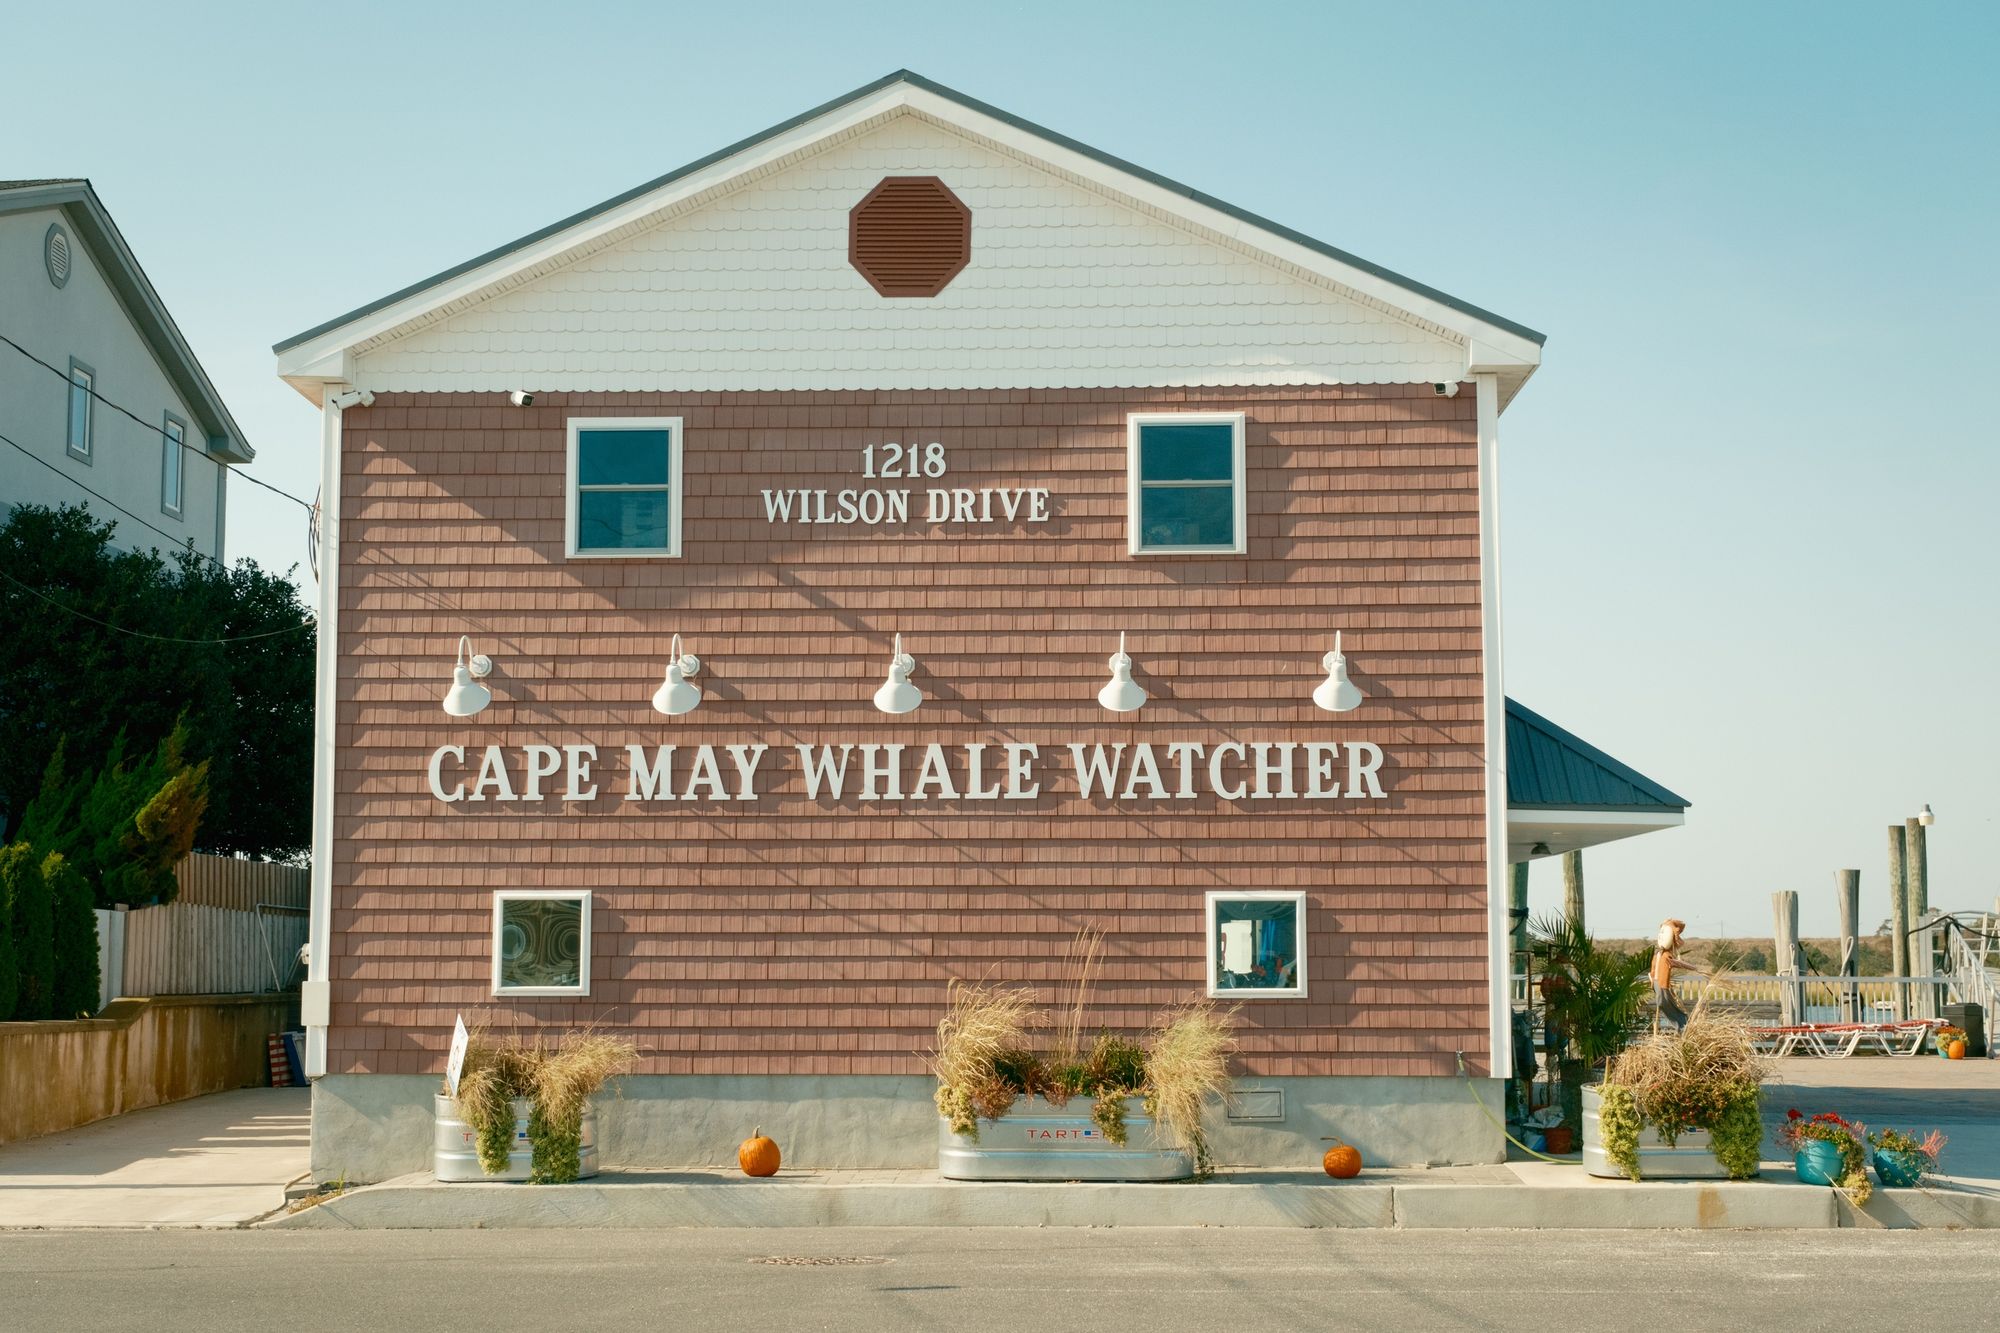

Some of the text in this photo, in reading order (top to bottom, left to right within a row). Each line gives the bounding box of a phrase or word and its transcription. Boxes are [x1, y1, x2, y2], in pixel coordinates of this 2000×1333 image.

[862, 442, 947, 478] 1218
[760, 487, 1050, 524] WILSON DRIVE
[427, 741, 1389, 803] CAPE MAY WHALE WATCHER
[1026, 1128, 1106, 1140] TARTE
